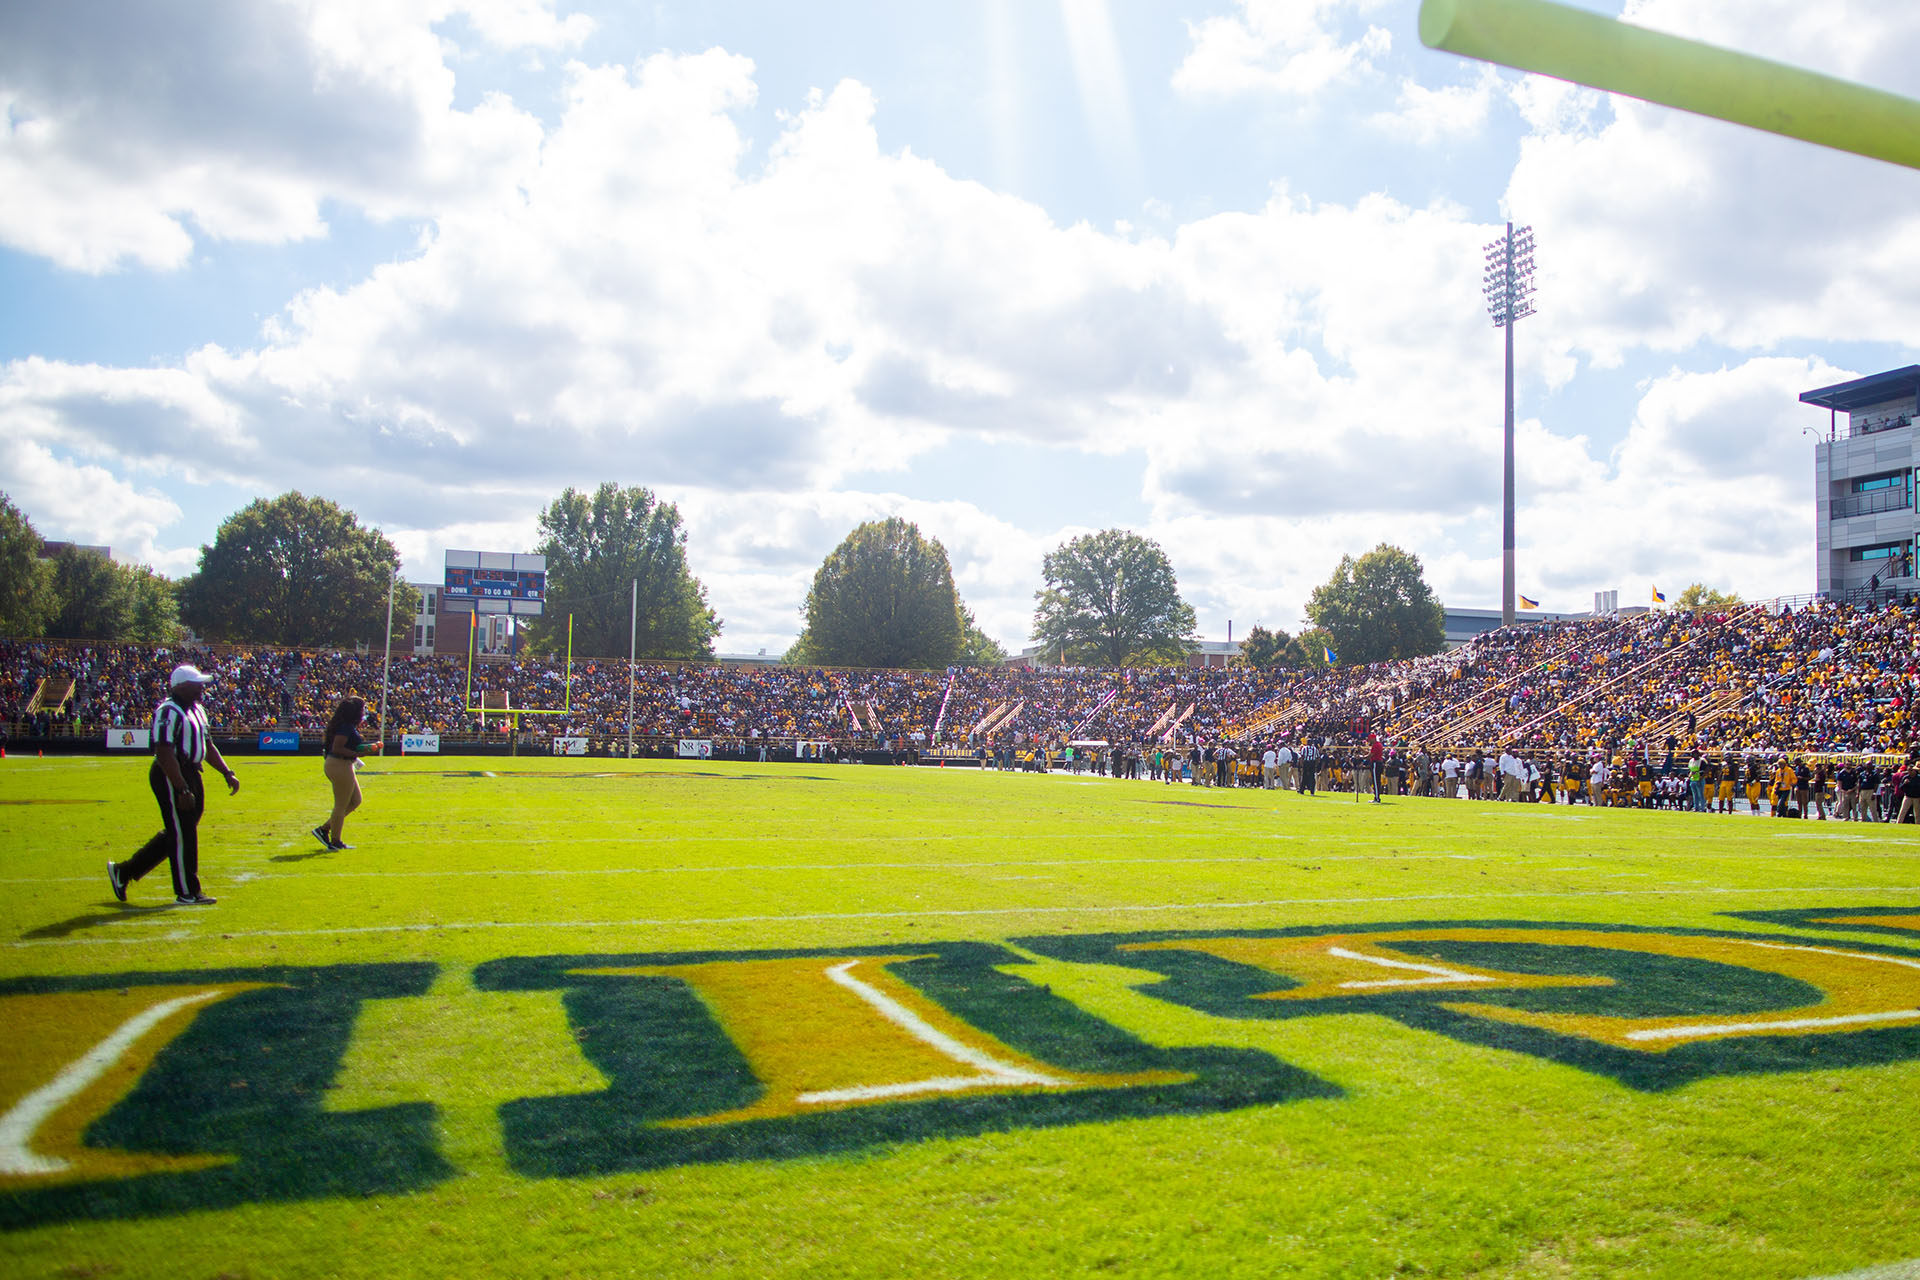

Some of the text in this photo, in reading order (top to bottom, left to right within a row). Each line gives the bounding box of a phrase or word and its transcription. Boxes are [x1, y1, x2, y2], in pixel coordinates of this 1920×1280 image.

[484, 588, 492, 596] TO
[493, 588, 501, 596] GO
[503, 588, 512, 596] ON
[527, 590, 538, 598] QTR
[699, 713, 715, 726] 25
[274, 736, 295, 745] pepsi
[425, 739, 436, 747] NC
